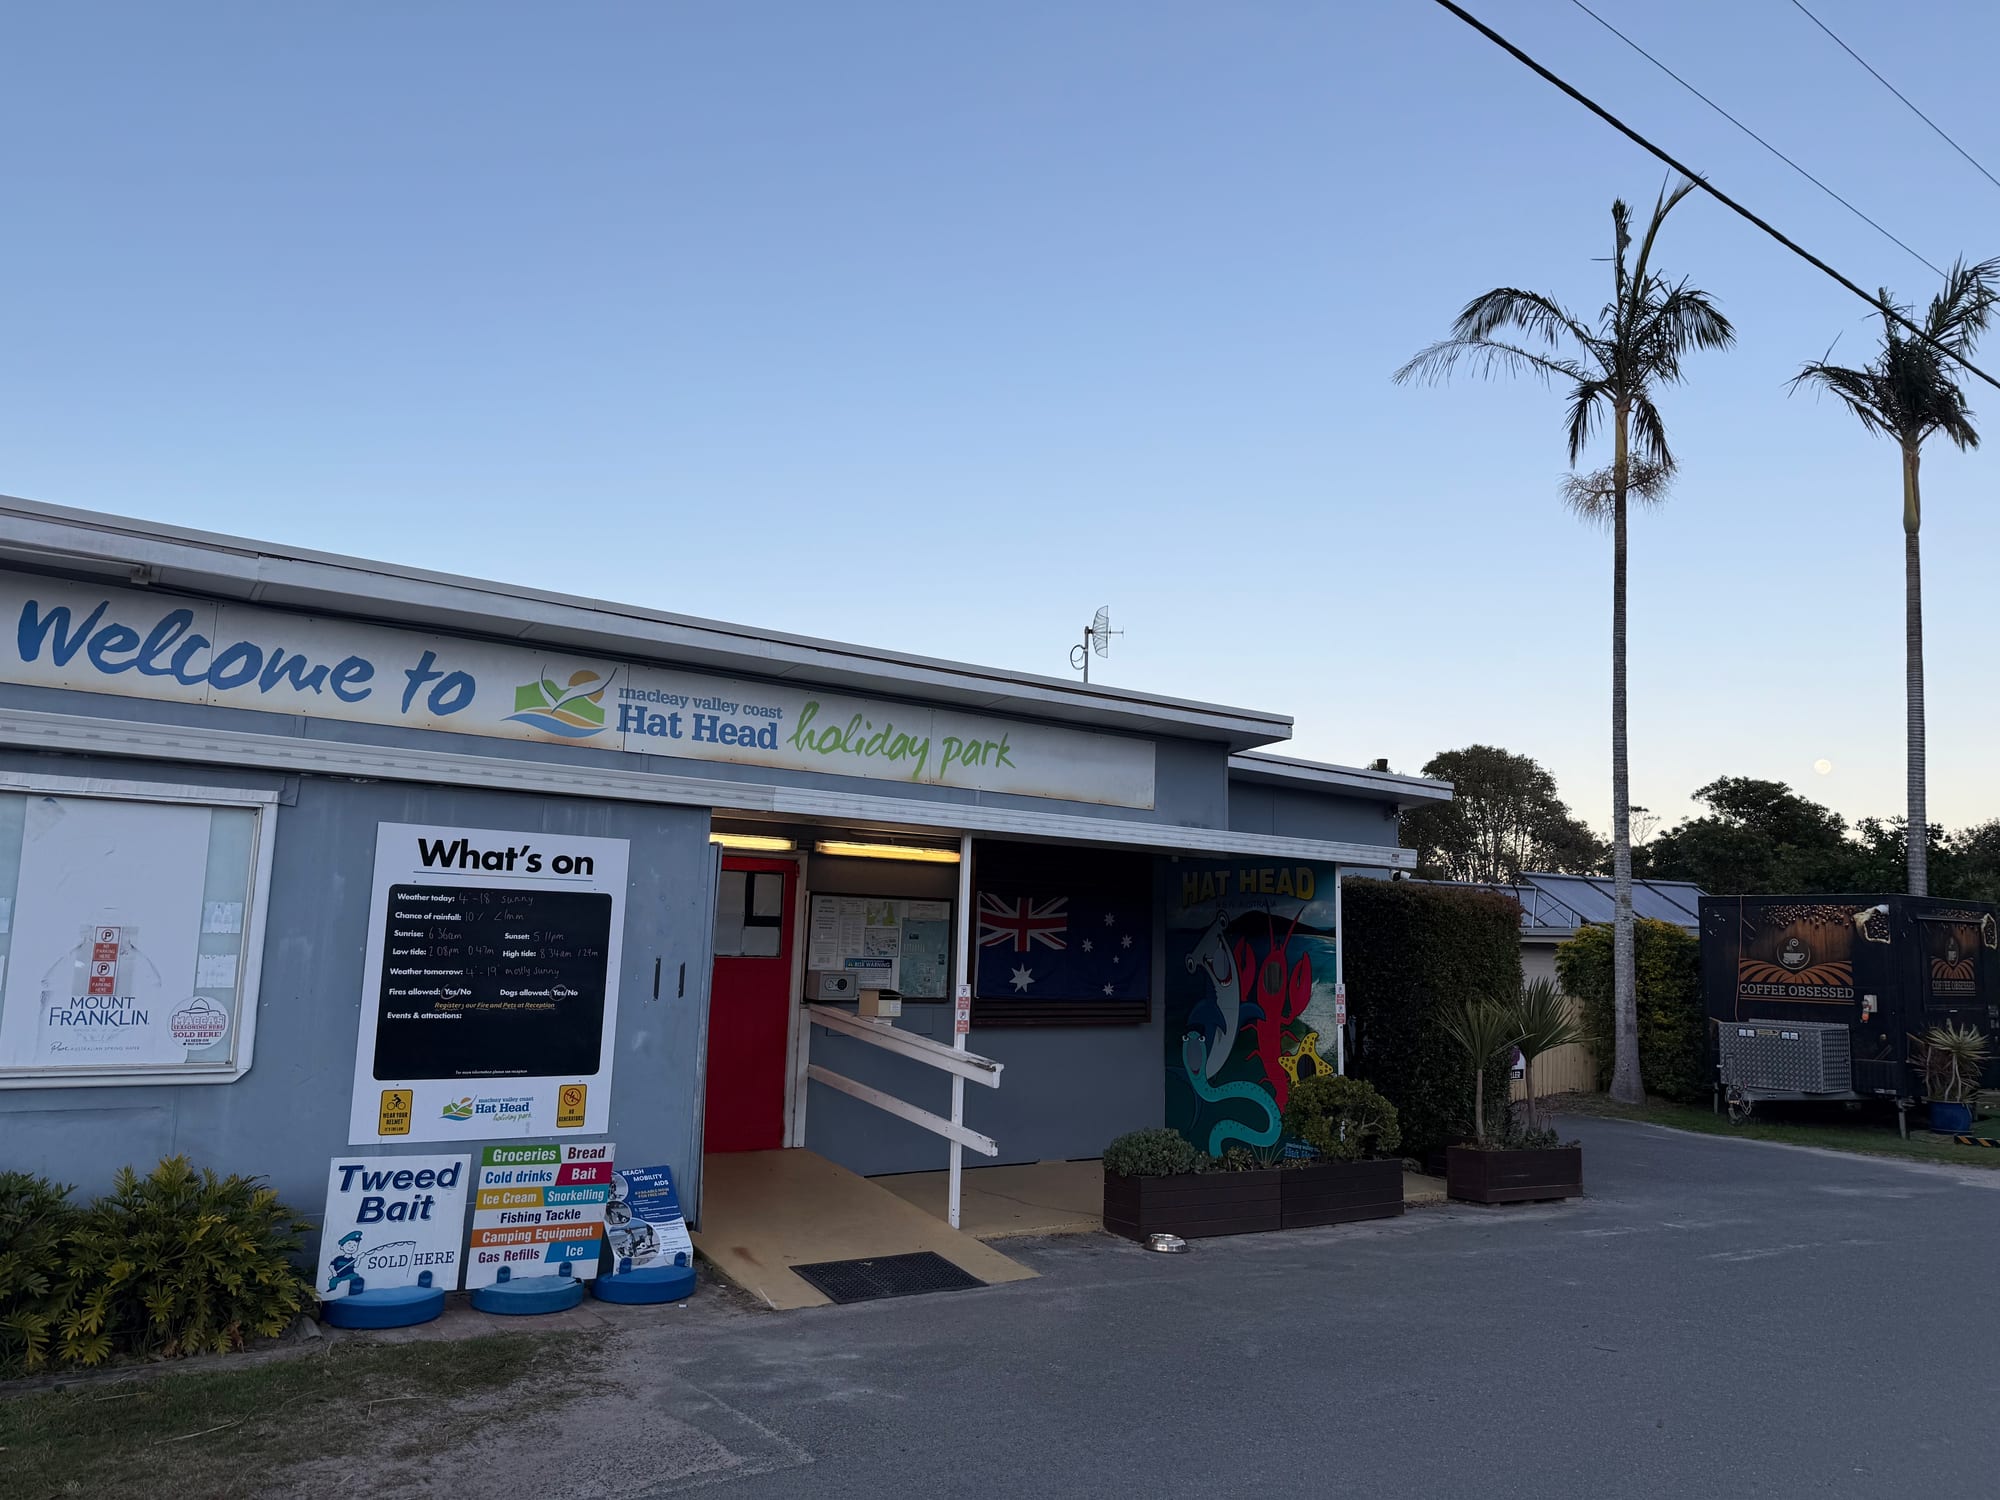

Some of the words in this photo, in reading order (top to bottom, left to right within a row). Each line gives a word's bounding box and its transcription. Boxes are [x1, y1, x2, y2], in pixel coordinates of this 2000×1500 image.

[17, 599, 375, 703] Welcome
[400, 650, 477, 716] to
[618, 686, 689, 710] macleay
[691, 694, 740, 716] valley
[742, 703, 783, 719] coast
[616, 702, 687, 740] Hat
[691, 711, 779, 751] Head
[786, 700, 931, 782] holiday
[939, 731, 1017, 780] park
[417, 837, 542, 874] What's
[551, 853, 595, 876] on
[1182, 870, 1231, 907] HAT
[1239, 866, 1315, 901] HEAD
[397, 892, 430, 902] Weather
[431, 893, 456, 904] today:
[500, 895, 535, 906] sunny
[394, 911, 422, 921] Chance
[423, 912, 432, 921] of
[432, 913, 462, 921] rainfall:
[393, 929, 424, 938] Sunrise:
[504, 932, 530, 941] Sunset:
[392, 947, 409, 955] Low
[409, 947, 427, 956] tide:
[502, 950, 520, 959] High
[520, 950, 537, 958] tide:
[389, 967, 423, 976] Weather
[423, 967, 464, 976] tomorrow:
[505, 965, 531, 977] mostly
[388, 988, 406, 996] Fires
[407, 988, 441, 996] allowed:
[443, 988, 472, 996] Yes/No
[499, 989, 518, 998] Dogs
[519, 988, 550, 997] allowed:
[552, 989, 579, 997] Yes/No
[1739, 983, 1786, 995] COFFEE
[1788, 985, 1855, 999] OBSESSED
[69, 996, 136, 1010] MOUNT
[49, 1007, 149, 1027] FRANKLIN
[386, 1011, 412, 1019] Events
[412, 1011, 420, 1019] &
[420, 1011, 463, 1020] attractions:
[475, 1103, 497, 1113] Hat
[499, 1102, 529, 1113] Head
[492, 1148, 557, 1163] Groceries
[567, 1146, 606, 1161] Bread
[337, 1161, 461, 1192] Tweed
[485, 1170, 514, 1185] Cold
[516, 1169, 553, 1183] drinks
[571, 1167, 597, 1181] Bait
[622, 1168, 645, 1177] BEACH
[633, 1173, 663, 1183] MOBILITY
[654, 1179, 669, 1187] AIDS
[482, 1193, 498, 1206] Ice
[501, 1192, 537, 1204] Cream
[547, 1188, 605, 1203] Snorkelling
[356, 1193, 434, 1224] Bait
[500, 1210, 542, 1226] Fishing
[544, 1208, 582, 1221] Tackle
[482, 1230, 532, 1246] Camping
[534, 1226, 593, 1242] Equipment
[367, 1253, 409, 1270] SOLD
[413, 1250, 455, 1267] HERE
[478, 1251, 501, 1264] Gas
[503, 1248, 541, 1262] Refills
[566, 1245, 584, 1257] Ice
